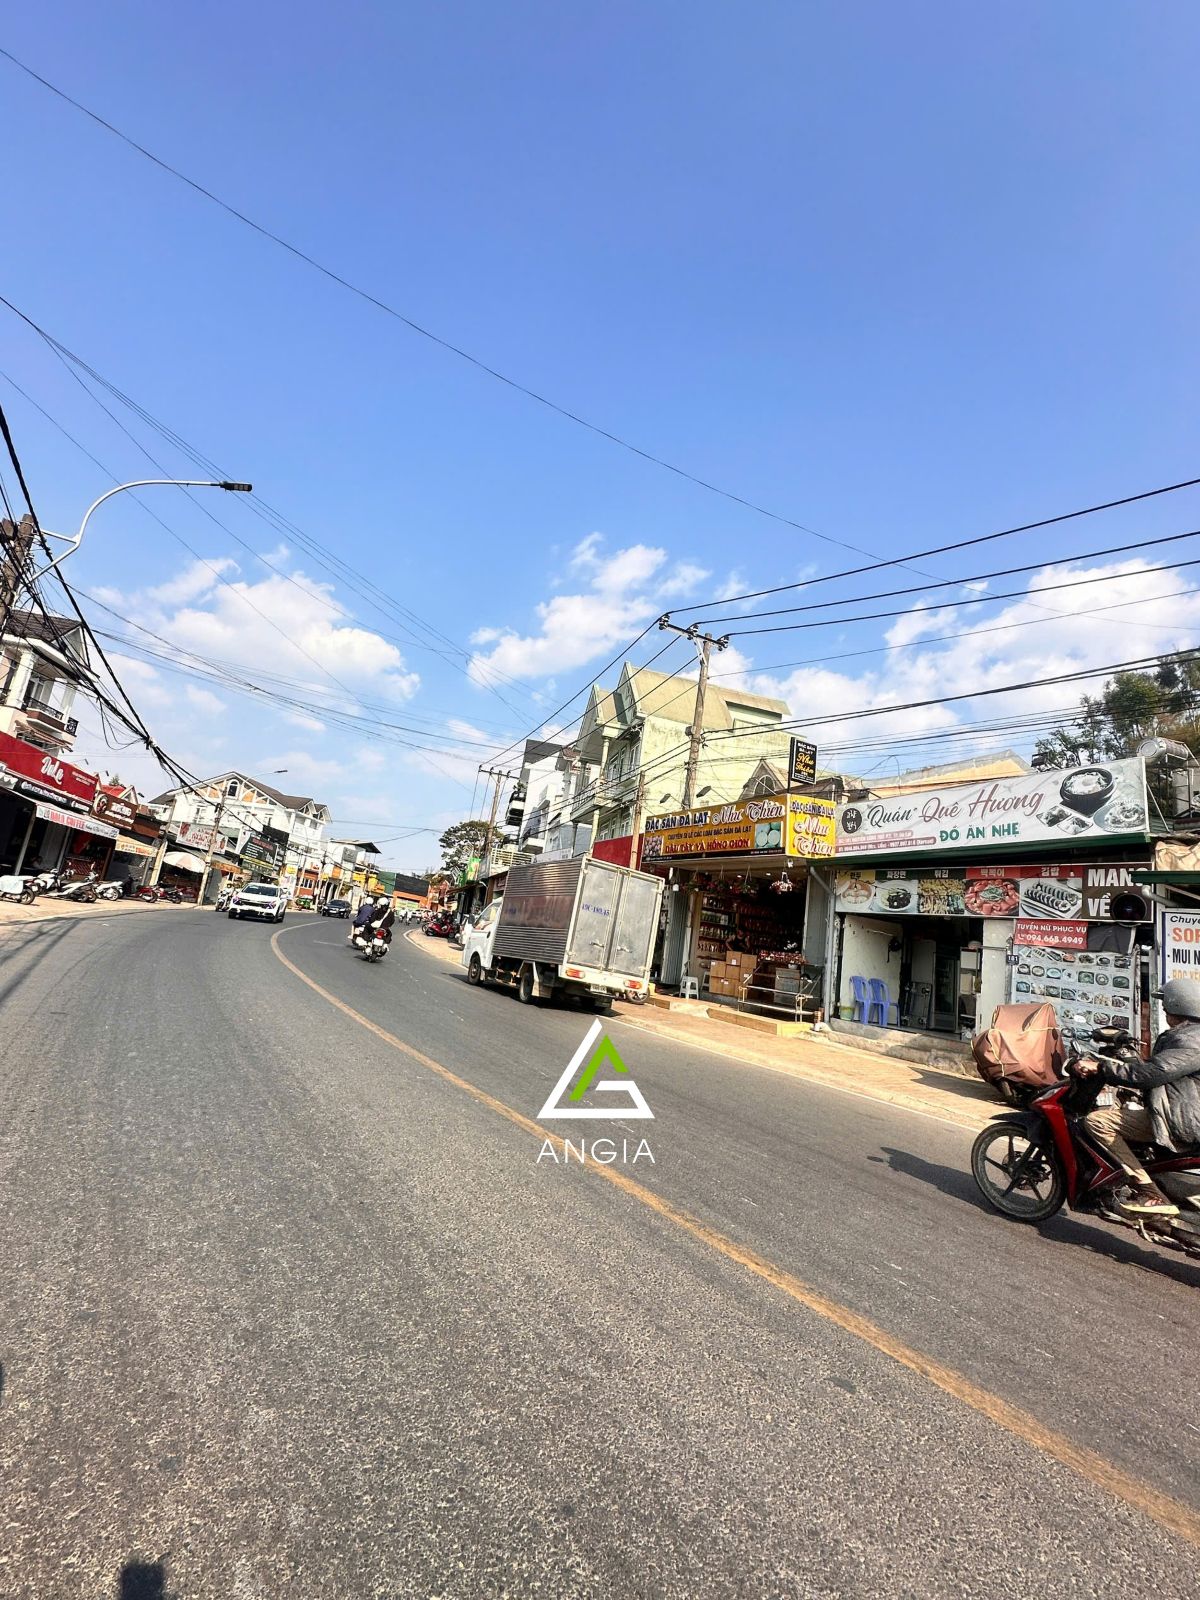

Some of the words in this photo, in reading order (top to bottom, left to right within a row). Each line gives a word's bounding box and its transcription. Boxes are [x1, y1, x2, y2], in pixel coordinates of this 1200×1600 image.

[867, 805, 912, 827] Quán
[919, 797, 962, 823] Quê
[968, 784, 1045, 819] Hương
[645, 817, 660, 833] ĐẶC
[662, 815, 676, 829] SẢN
[679, 812, 692, 826] ĐÀ
[694, 811, 710, 827] LẠT
[712, 805, 744, 825] Như
[745, 800, 785, 822] Thiên
[794, 816, 830, 835] Như
[939, 825, 960, 842] ĐỒ
[966, 825, 985, 840] ĂN
[992, 822, 1019, 837] NHẸ
[794, 834, 833, 855] Thiên
[1042, 867, 1060, 876] 김밥
[1088, 892, 1111, 916] VỀ
[1026, 934, 1083, 945] 094.668.4949
